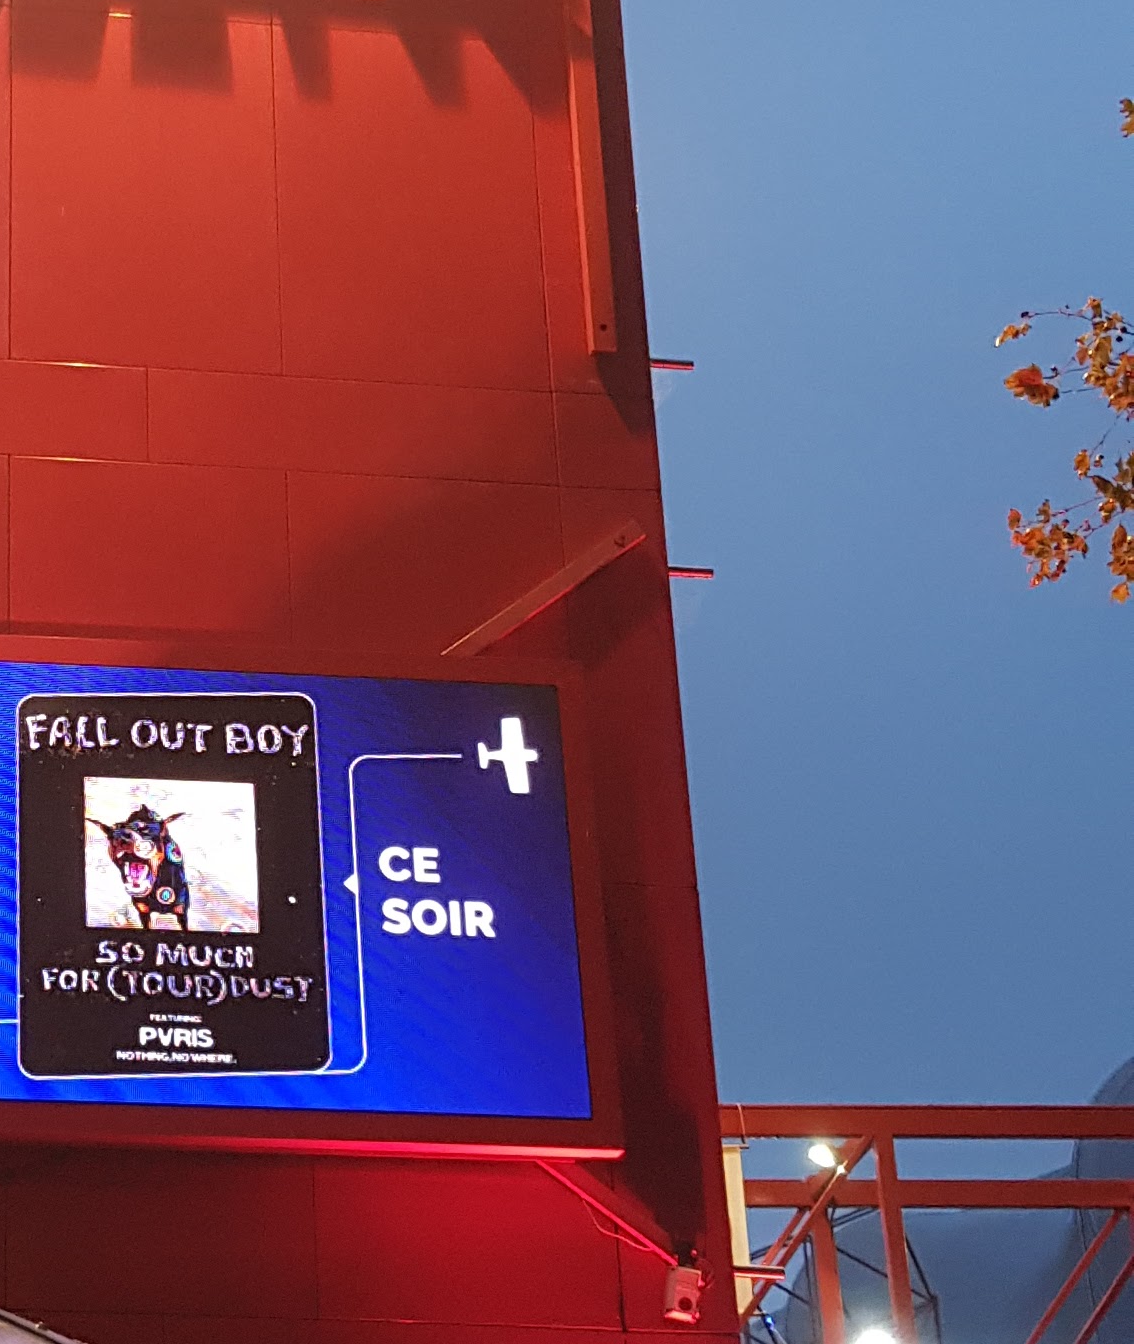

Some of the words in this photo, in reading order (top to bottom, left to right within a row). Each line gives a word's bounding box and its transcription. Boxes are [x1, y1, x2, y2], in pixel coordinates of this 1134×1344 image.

[25, 714, 120, 751] FALL
[130, 719, 214, 753] OUT
[225, 723, 310, 757] BOY
[378, 846, 442, 884] CE
[381, 897, 497, 938] SOIR
[95, 940, 146, 965] SO
[41, 967, 100, 994] FOR
[138, 1026, 215, 1049] PVRIS
